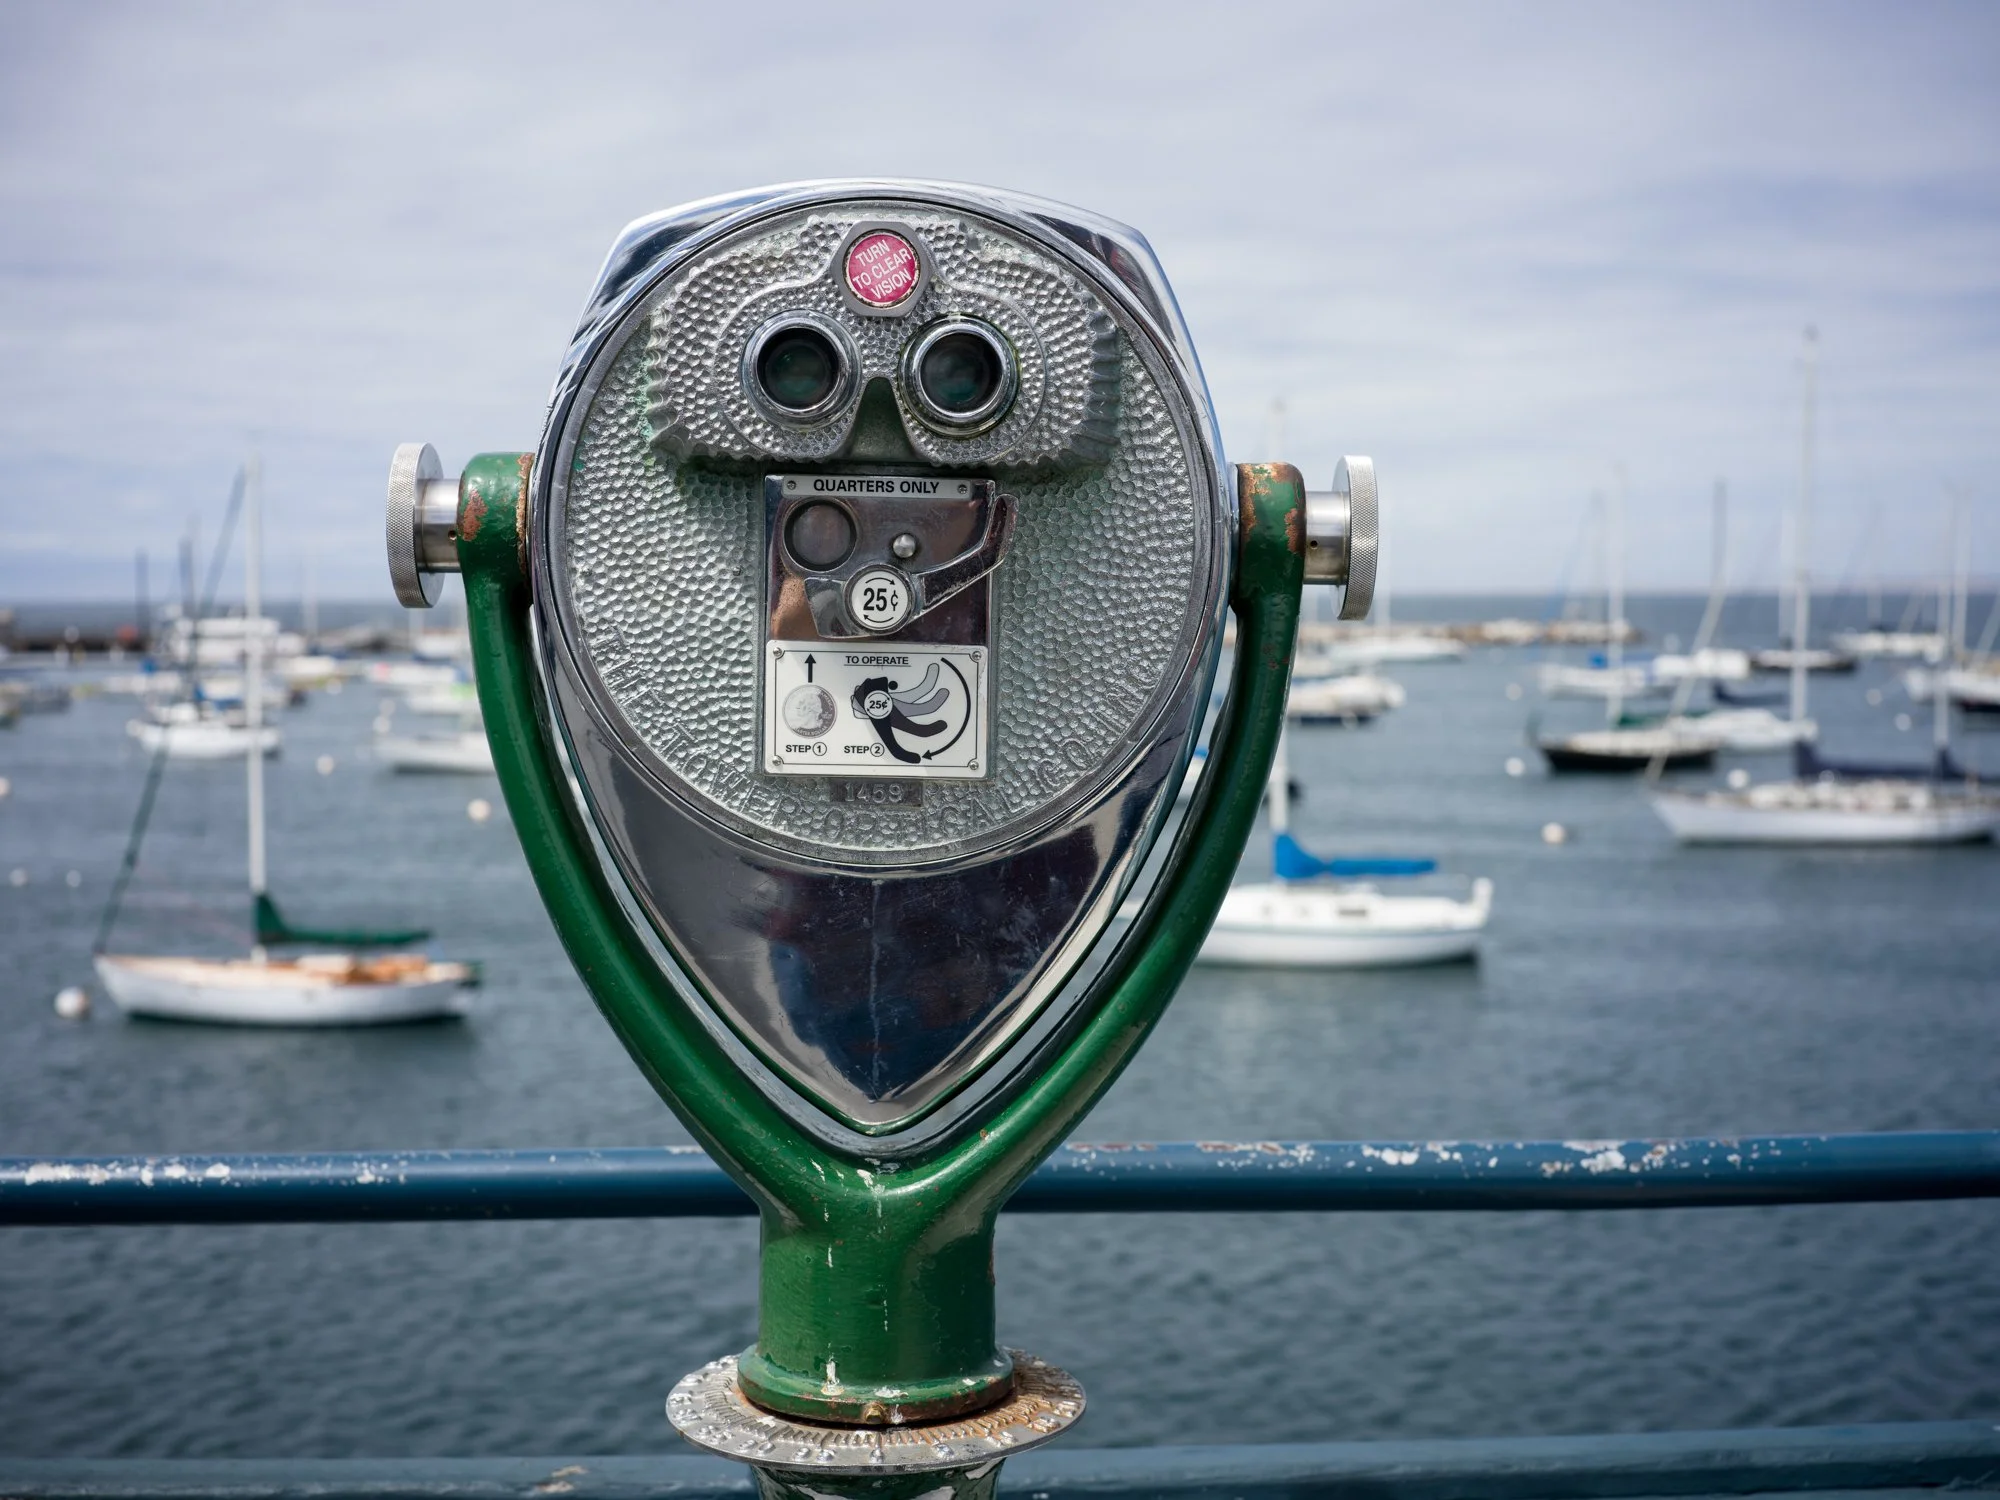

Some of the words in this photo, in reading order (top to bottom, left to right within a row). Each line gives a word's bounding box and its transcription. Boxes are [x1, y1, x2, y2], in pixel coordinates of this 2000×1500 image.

[855, 240, 890, 266] TURN
[853, 271, 871, 289] TO
[872, 248, 911, 278] CLEAR
[871, 268, 911, 299] VISION
[813, 479, 894, 493] QUARTERS
[900, 480, 939, 494] ONLY
[846, 656, 859, 664] TO
[862, 656, 908, 665] OPERATE
[844, 745, 869, 754] STEP
